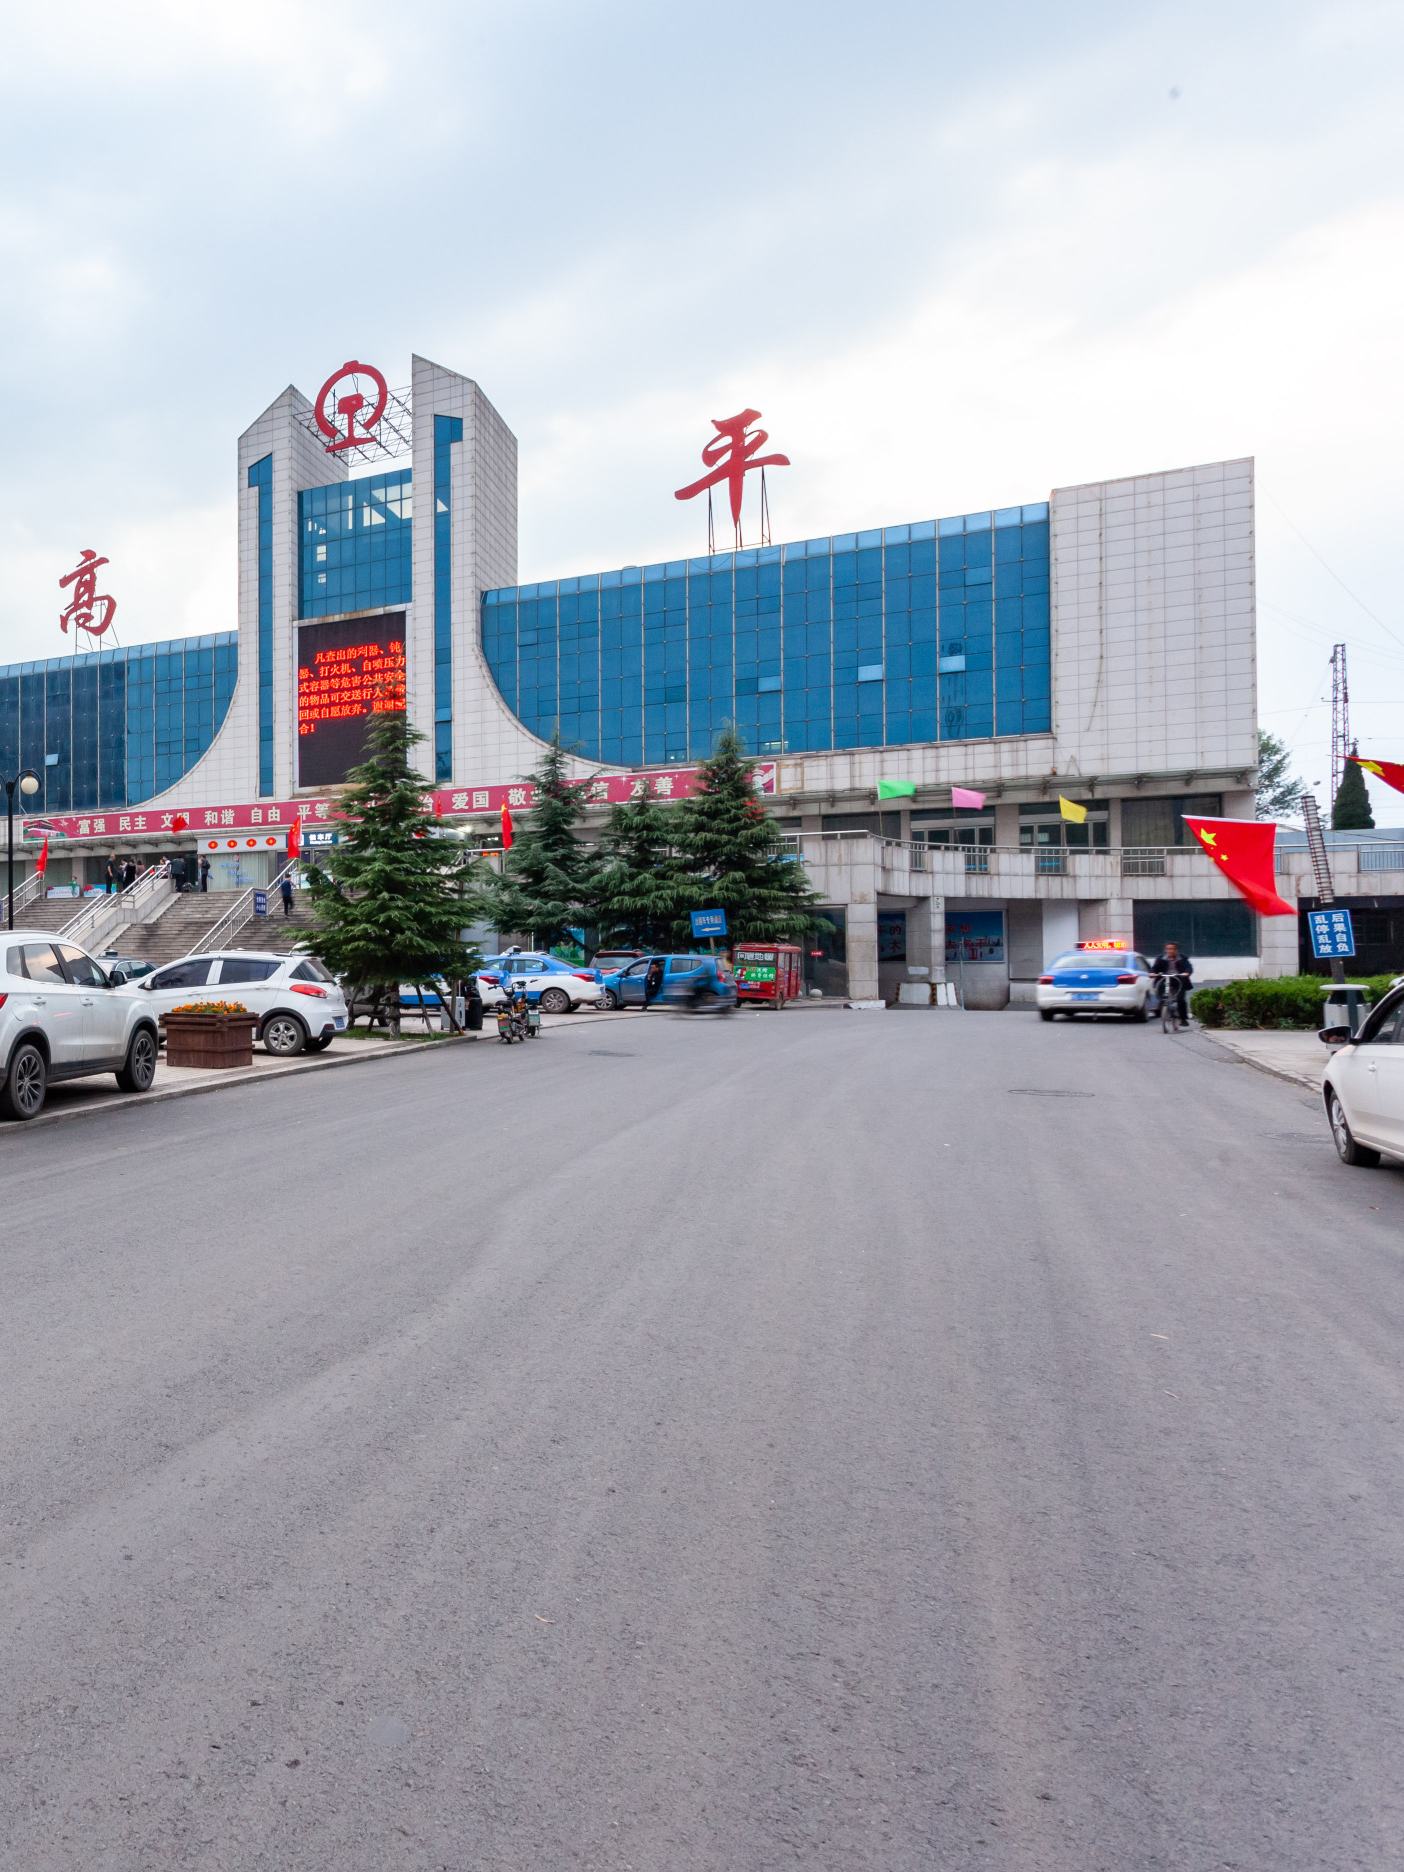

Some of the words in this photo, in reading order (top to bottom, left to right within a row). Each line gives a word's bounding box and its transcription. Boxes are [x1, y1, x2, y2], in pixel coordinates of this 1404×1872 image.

[59, 549, 117, 636] 高
[674, 408, 791, 528] 平
[78, 818, 106, 834] 富强
[119, 815, 147, 832] 民主
[204, 809, 235, 826] 和谐
[251, 806, 281, 823] 自由
[297, 803, 330, 821] 平等
[451, 791, 489, 810] 爱国
[630, 776, 674, 797] 友善
[1314, 914, 1333, 953] 乱停乱放
[1331, 913, 1350, 952] 后果自负
